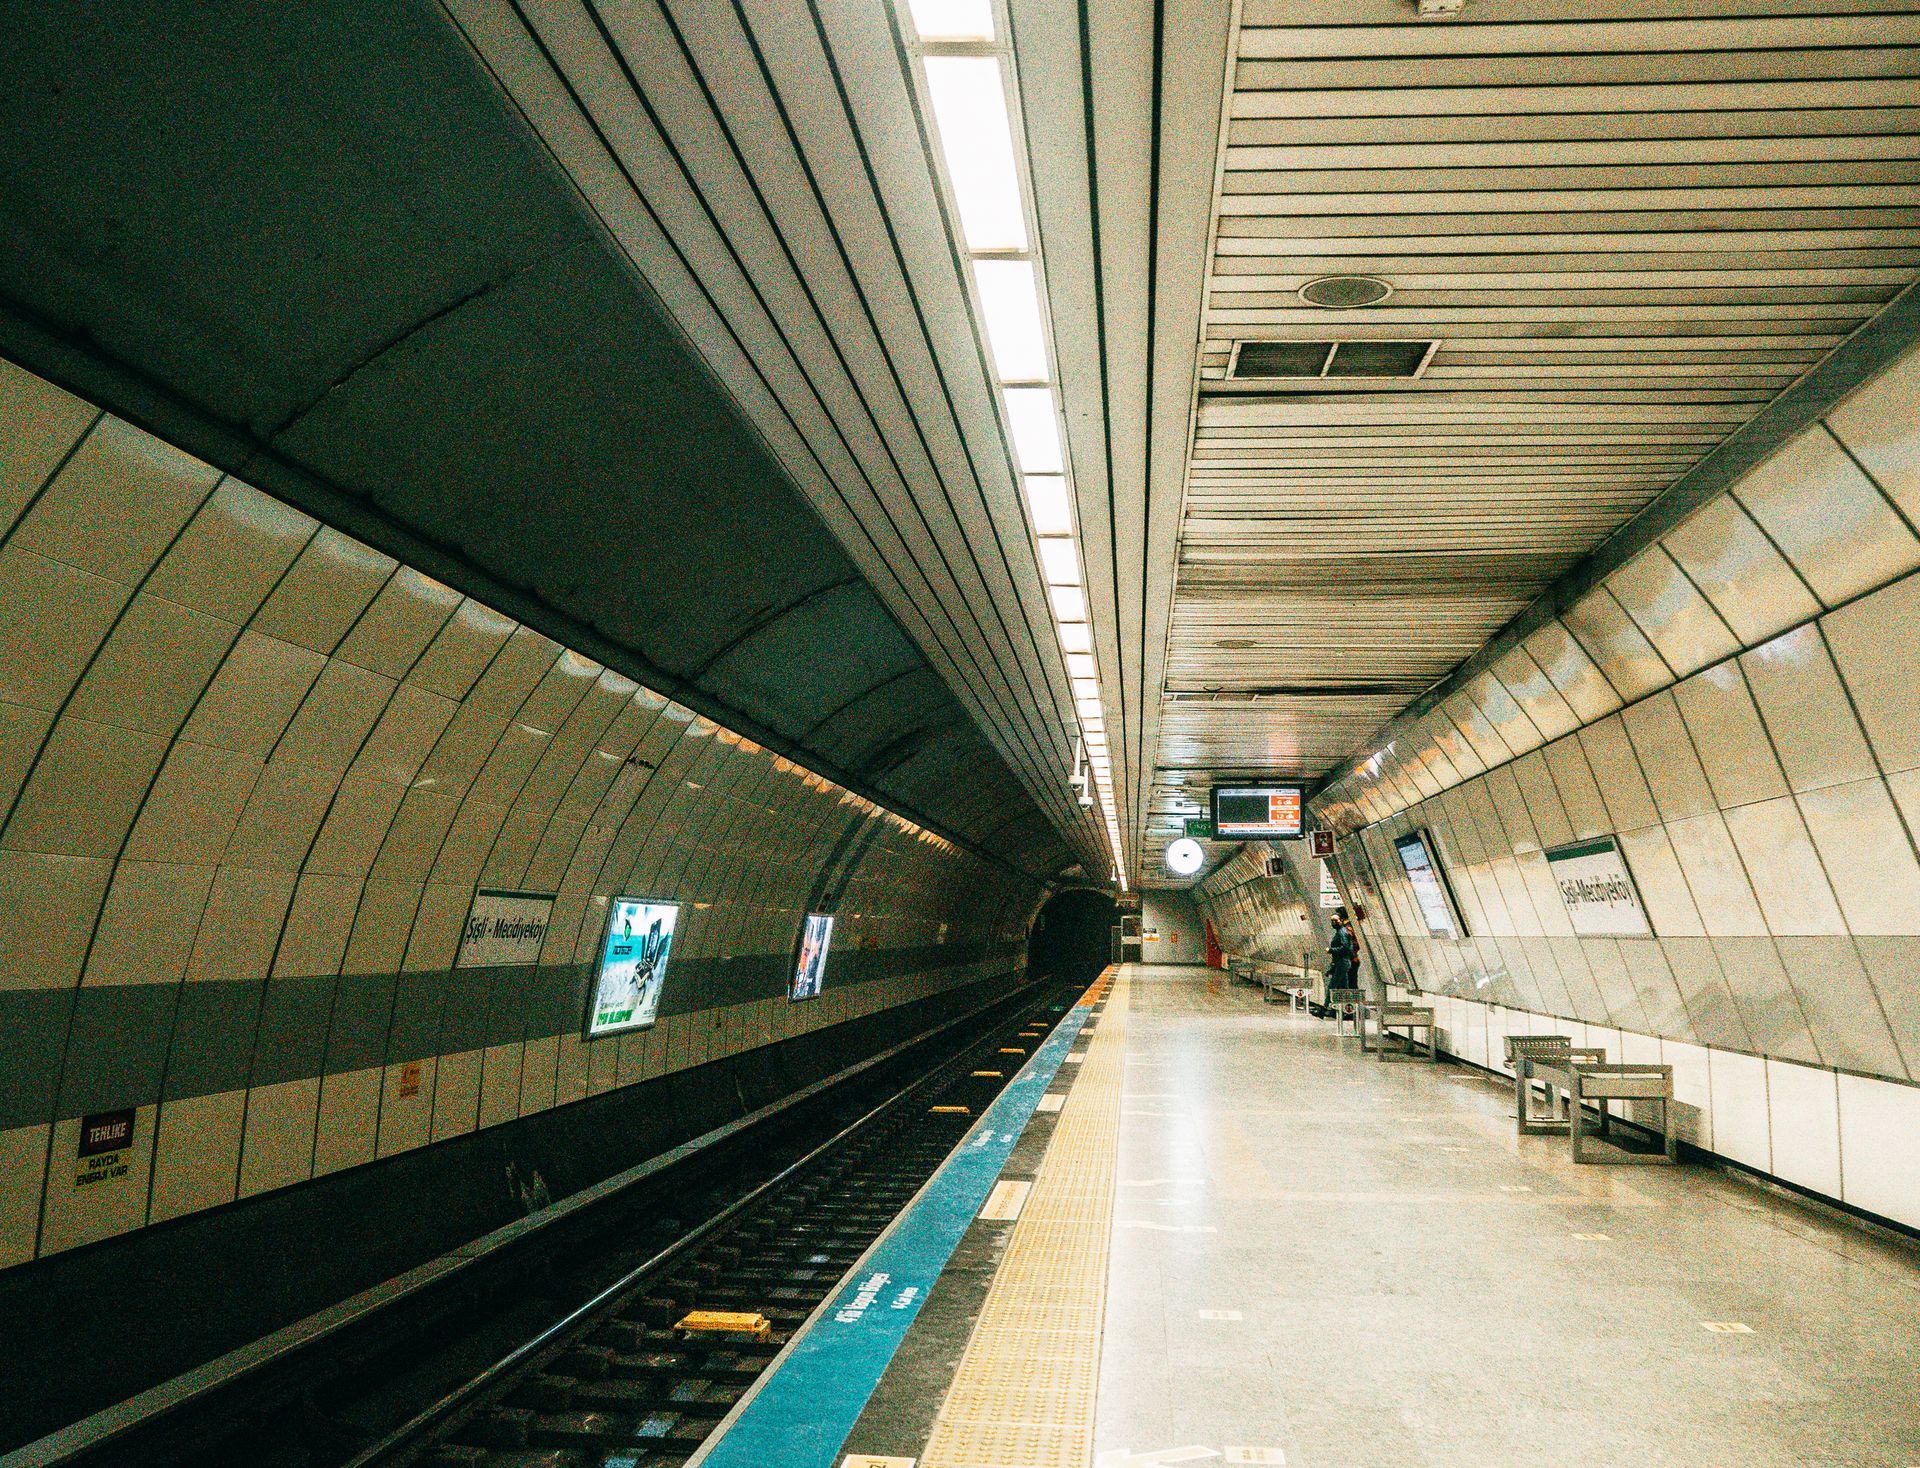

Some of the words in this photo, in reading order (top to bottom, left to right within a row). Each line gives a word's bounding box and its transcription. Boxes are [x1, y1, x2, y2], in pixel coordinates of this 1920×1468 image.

[466, 916, 489, 944] Şişli
[493, 917, 546, 943] Mecidiyeköy
[90, 1119, 127, 1143] TEHLİKE
[110, 1164, 128, 1178] VAR
